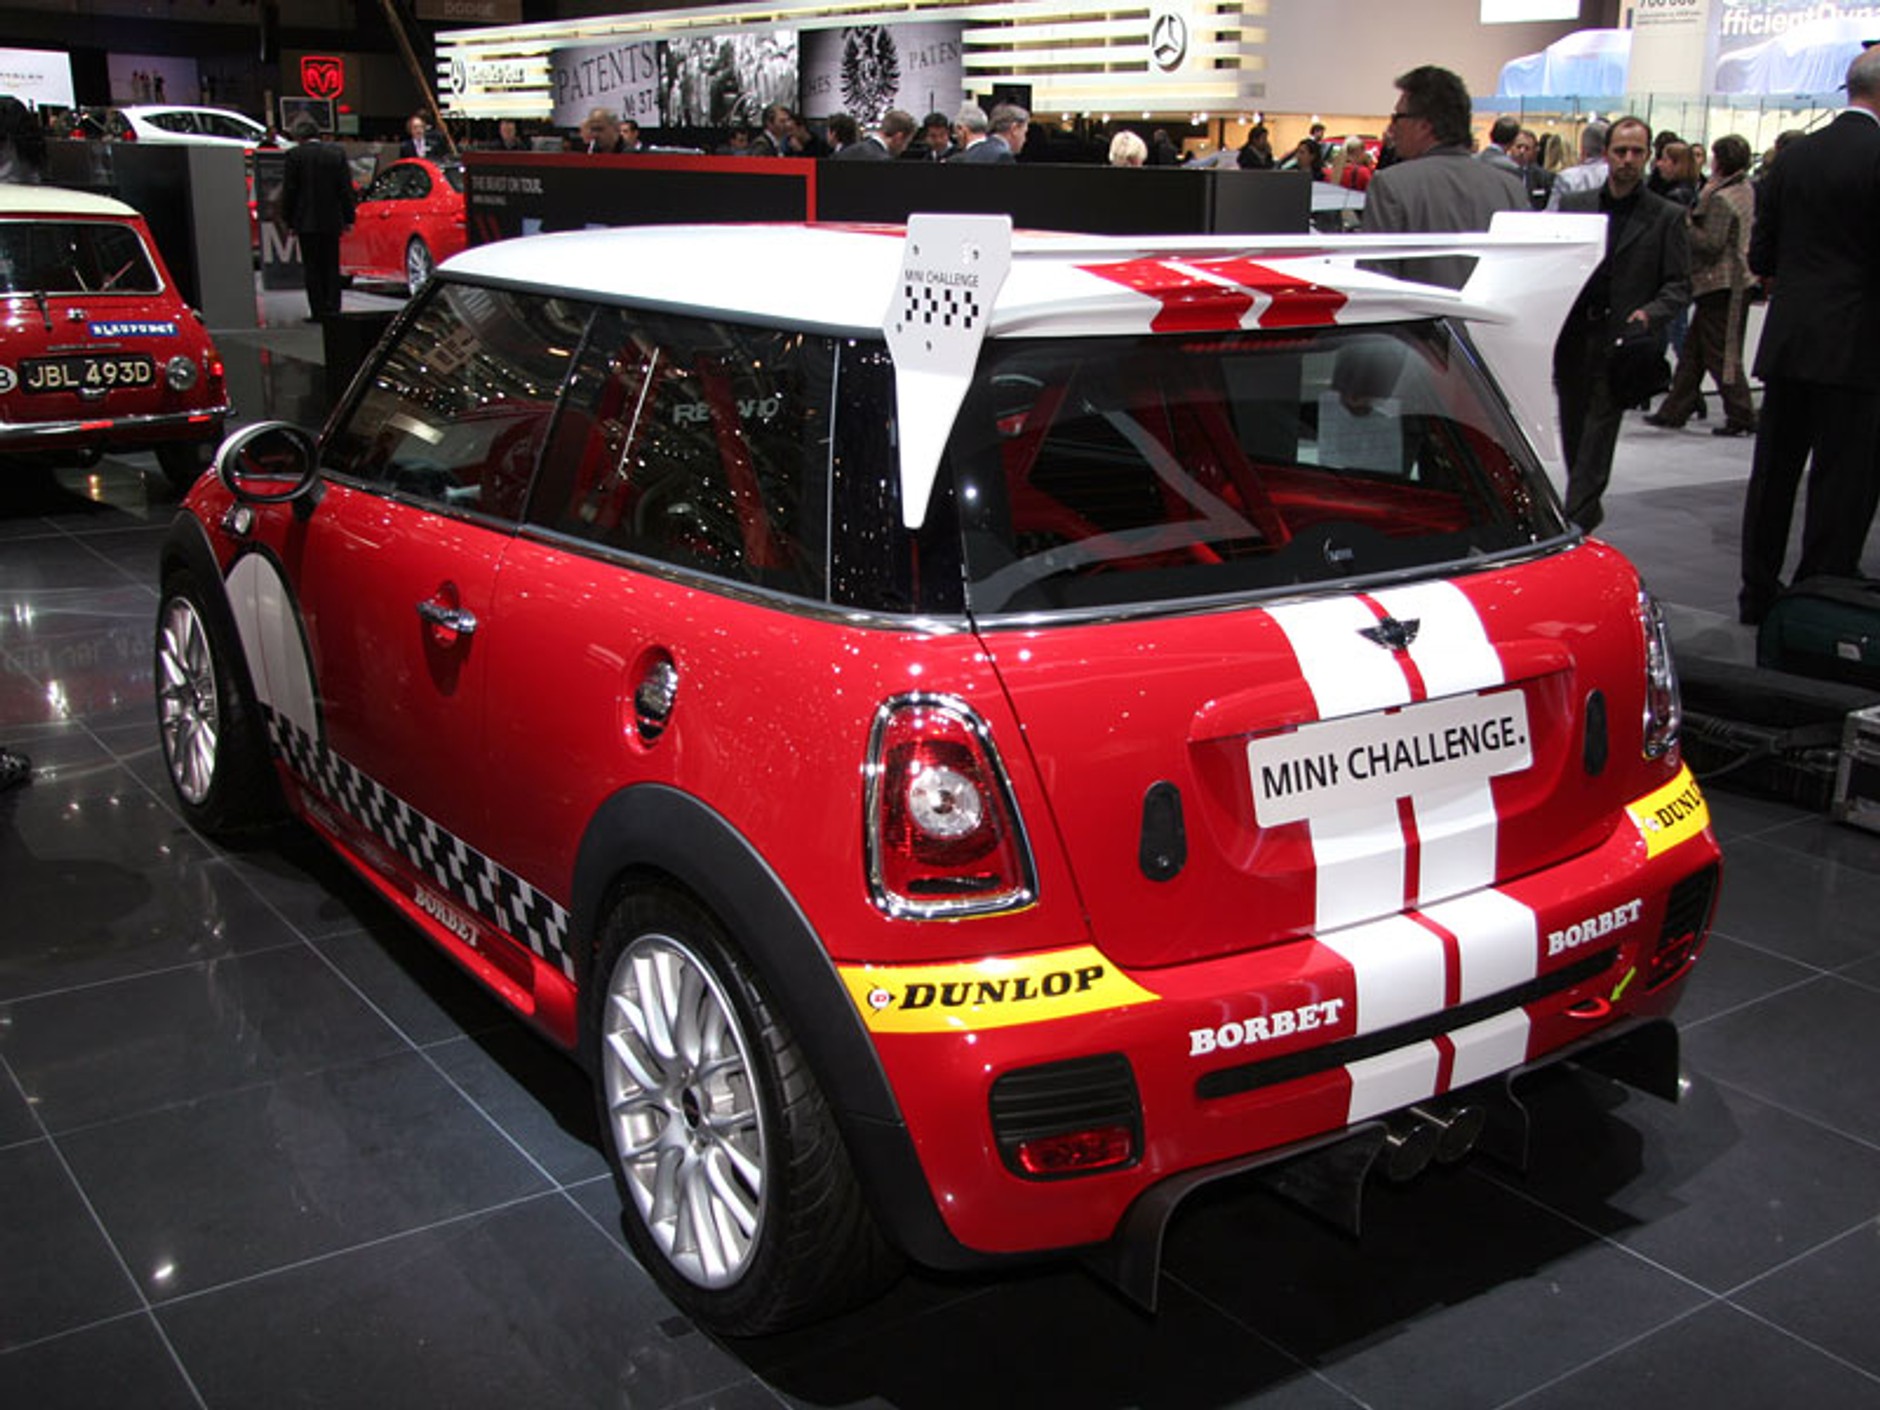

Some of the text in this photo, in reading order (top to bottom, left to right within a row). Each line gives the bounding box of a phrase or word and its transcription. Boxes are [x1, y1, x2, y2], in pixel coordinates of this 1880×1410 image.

[557, 41, 655, 106] PATENTS
[905, 269, 979, 288] MINI CHALLENGE
[28, 361, 151, 388] JBL 493D
[1262, 716, 1525, 799] MINI CHALLENGE.
[1546, 898, 1643, 957] BORBET
[898, 965, 1104, 1011] DUNLOP
[1188, 997, 1344, 1057] BORBET
